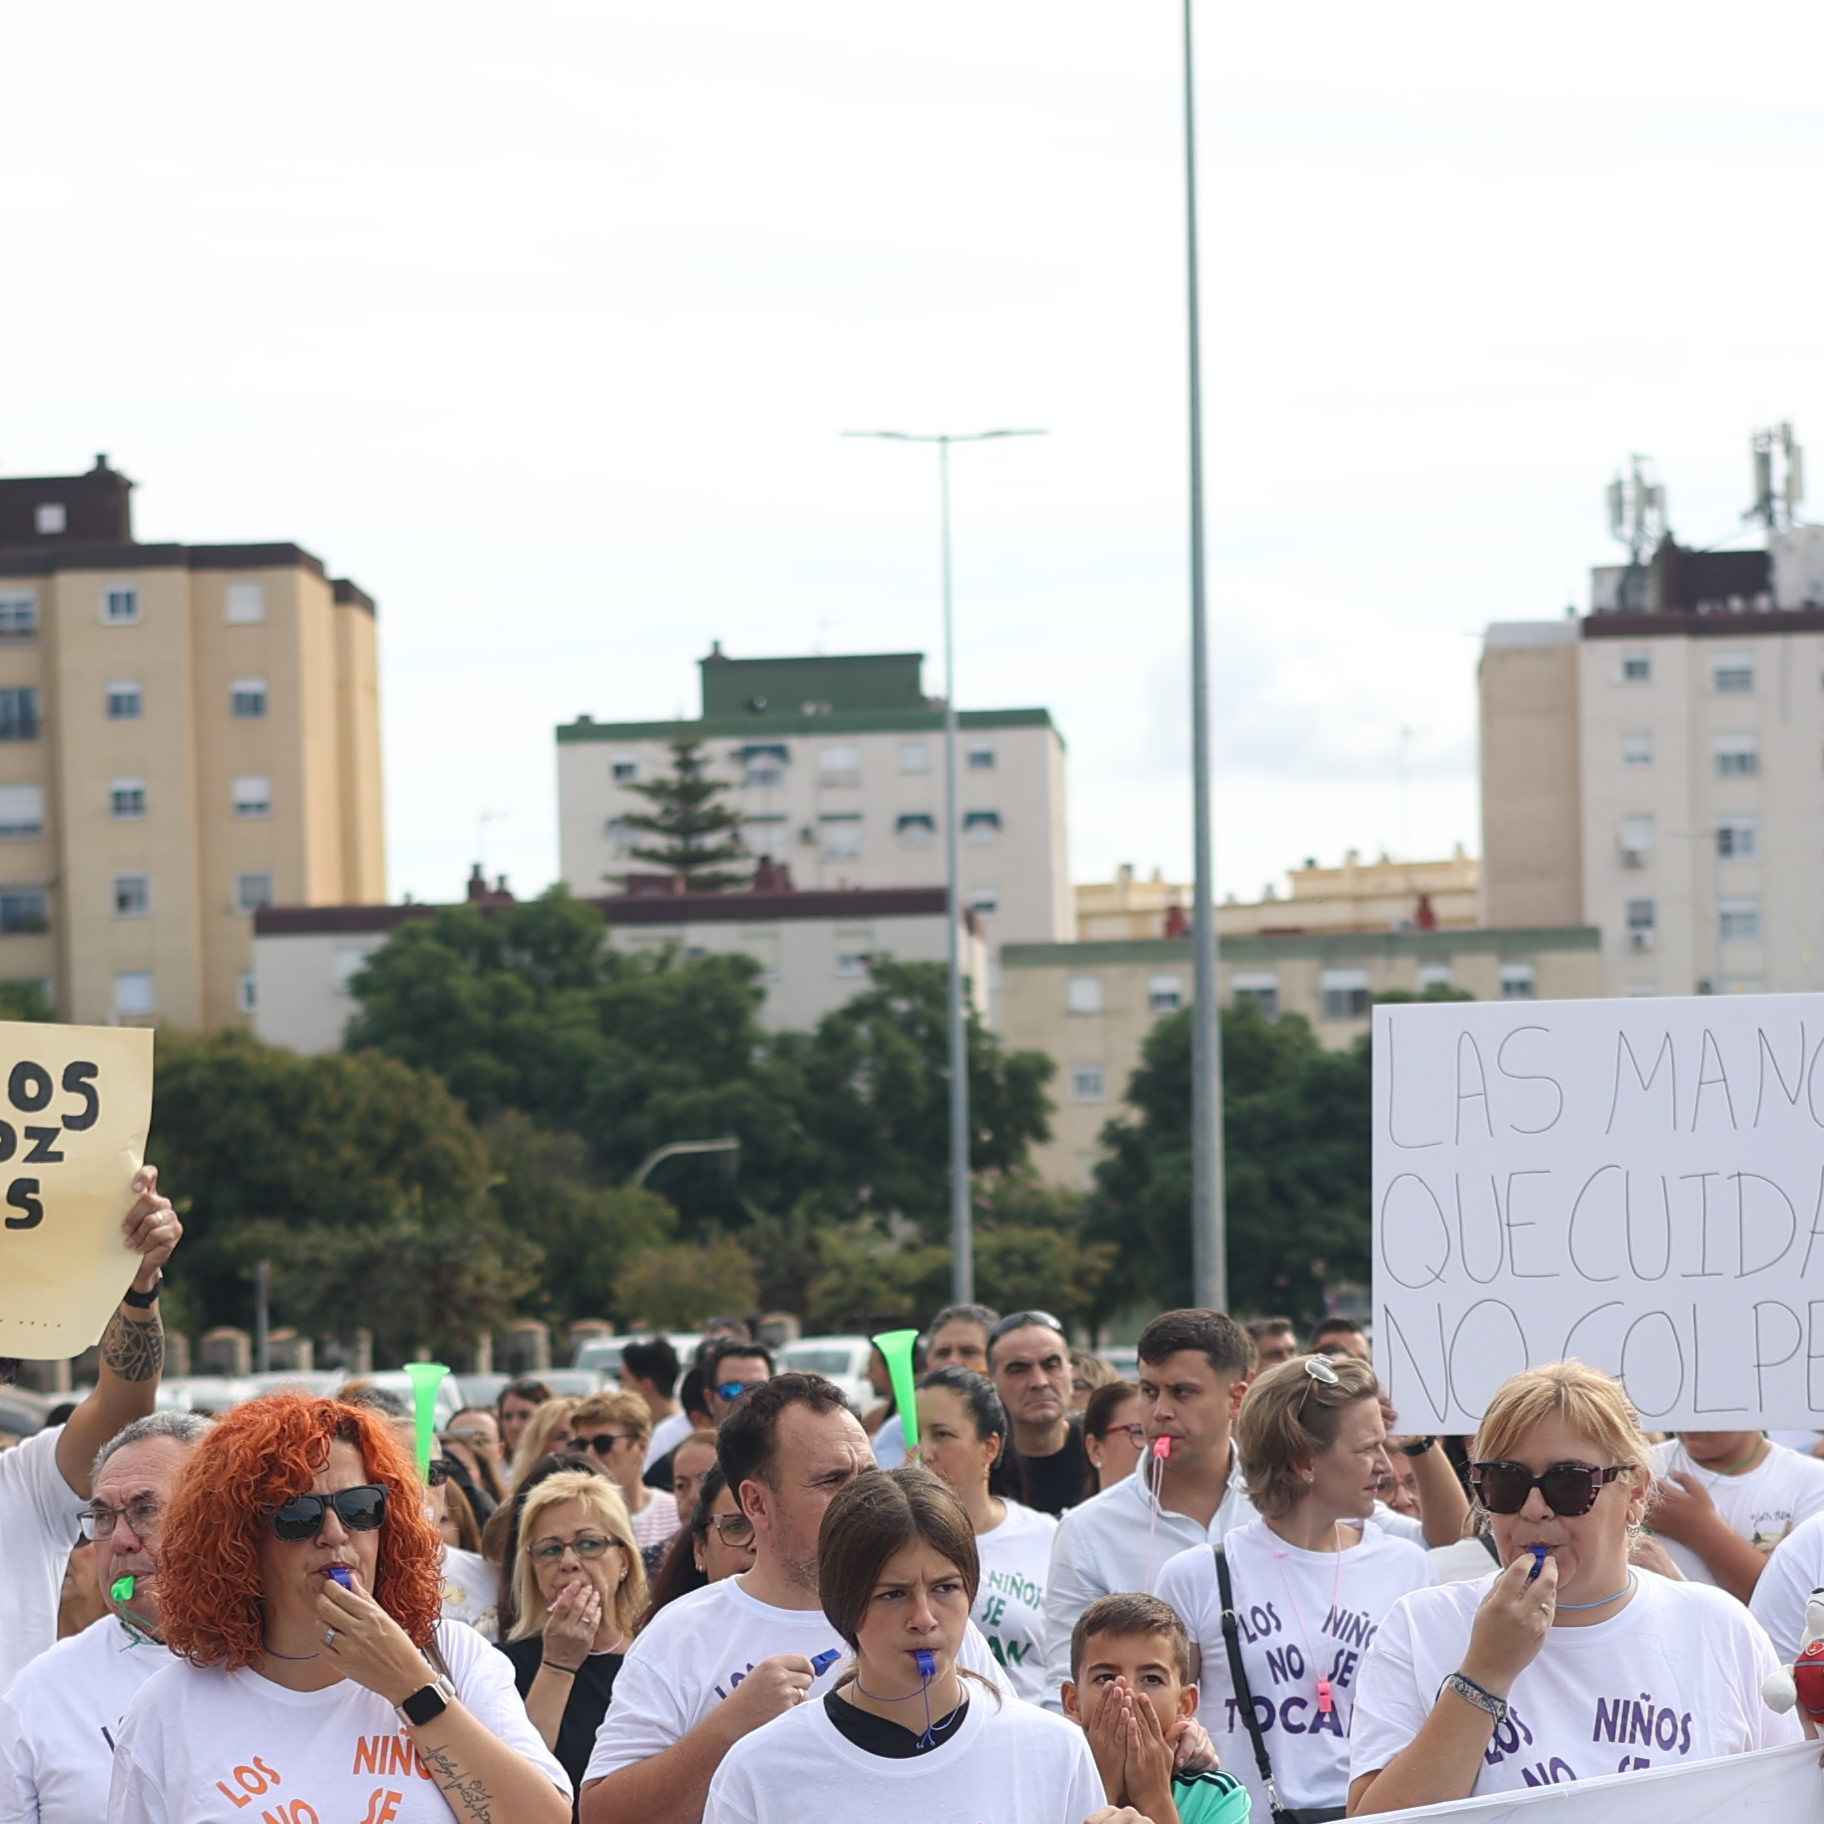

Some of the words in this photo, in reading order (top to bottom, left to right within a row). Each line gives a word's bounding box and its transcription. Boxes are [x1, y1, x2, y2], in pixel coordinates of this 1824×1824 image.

[1387, 1016, 1564, 1150] LAS
[1380, 1170, 1561, 1290] QUE
[1382, 1298, 1530, 1424] NO
[1238, 1600, 1283, 1645] LOS
[1265, 1643, 1305, 1685] NO
[1326, 1647, 1360, 1689] SE
[1592, 1691, 1694, 1756] NIÑOS
[215, 1754, 282, 1809] LOS
